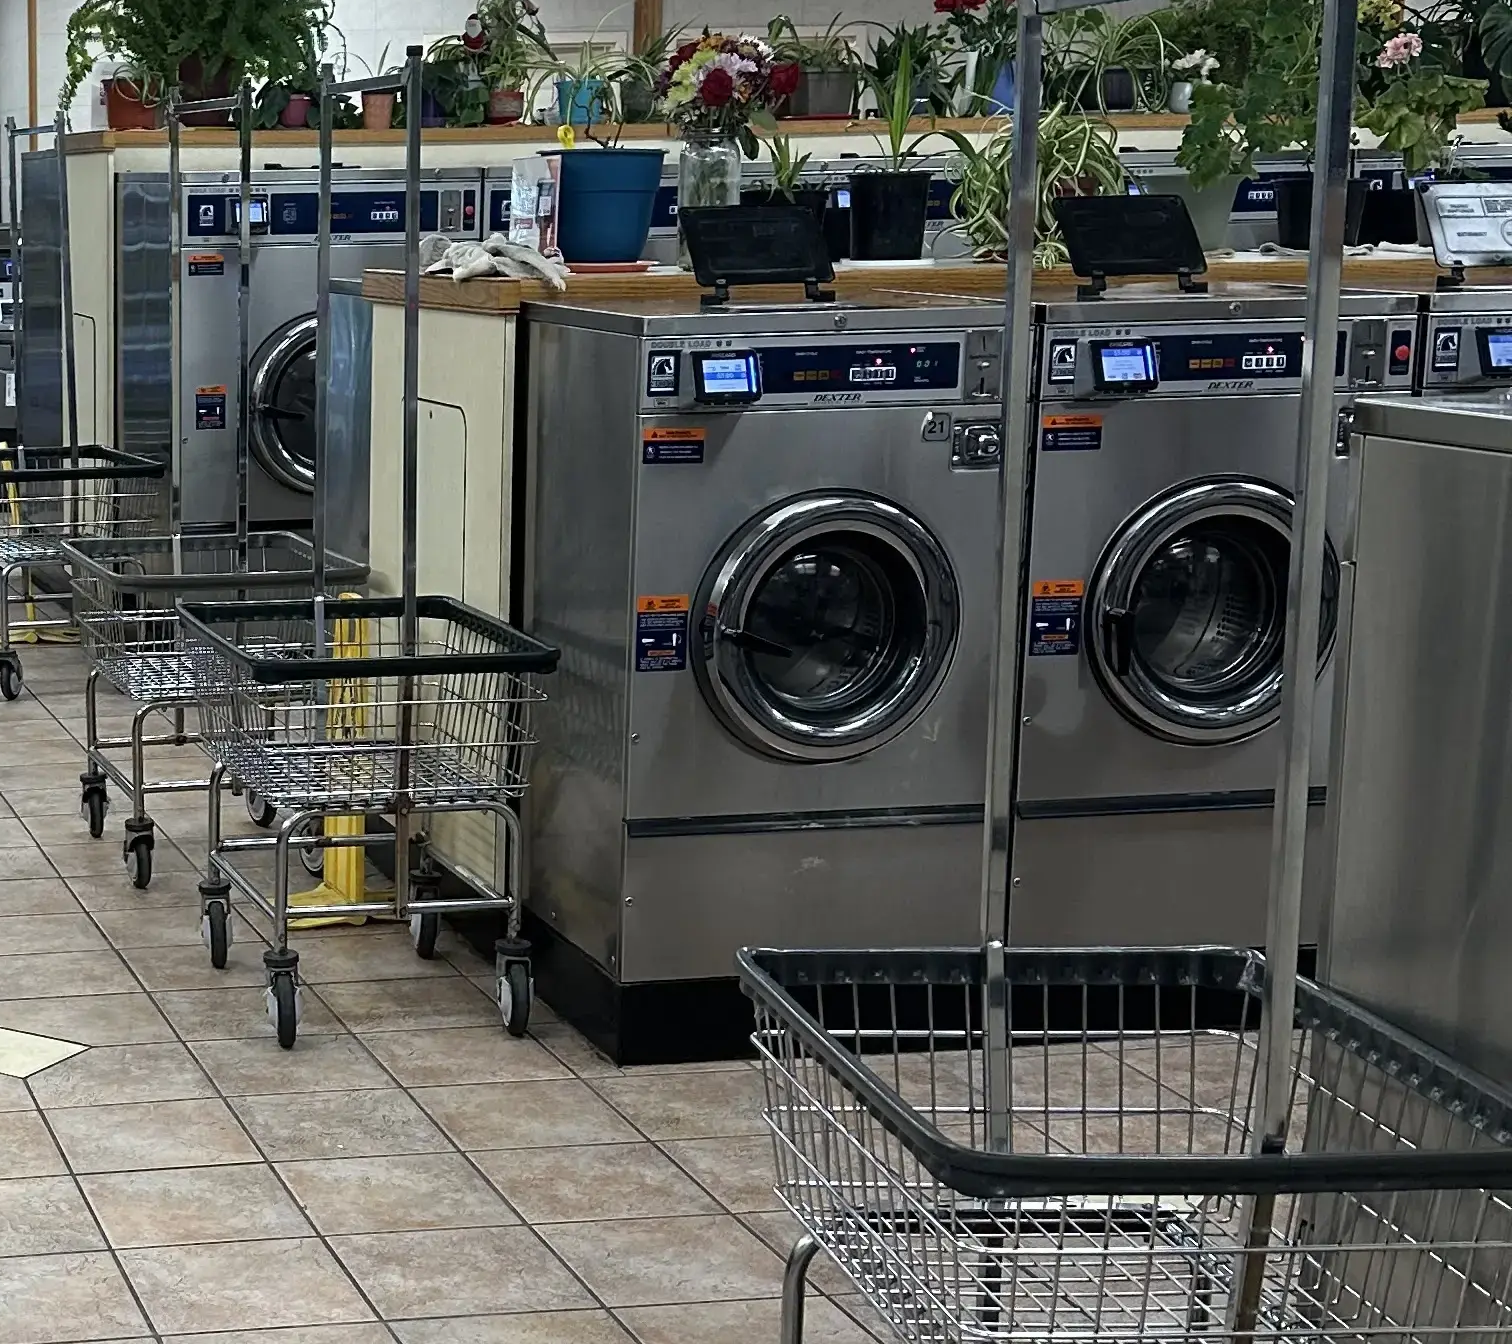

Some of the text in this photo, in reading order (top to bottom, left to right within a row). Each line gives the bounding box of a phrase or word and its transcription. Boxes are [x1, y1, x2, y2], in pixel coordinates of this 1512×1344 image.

[1088, 329, 1112, 337] LOAD
[650, 340, 712, 349] DOUBLE LOAD
[1208, 381, 1254, 389] DEXTER
[813, 393, 862, 402] DEXTER
[928, 421, 945, 434] 21
